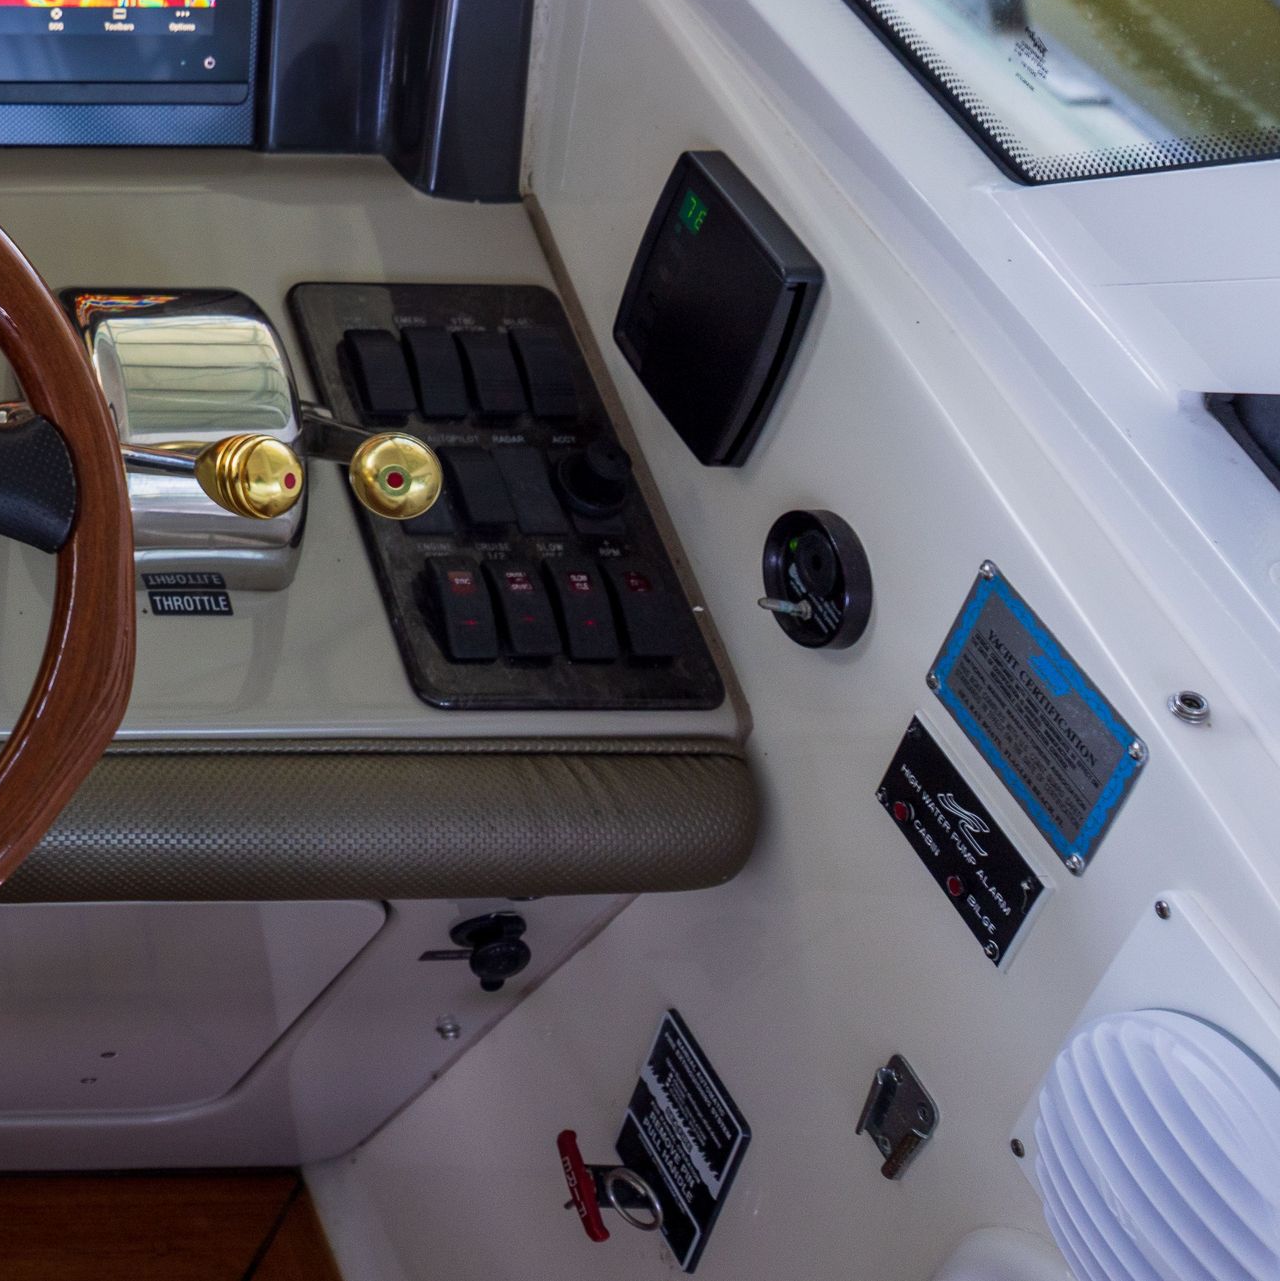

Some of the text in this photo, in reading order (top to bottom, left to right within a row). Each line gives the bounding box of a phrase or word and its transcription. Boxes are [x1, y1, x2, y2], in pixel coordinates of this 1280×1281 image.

[492, 435, 525, 444] RADAR
[152, 596, 230, 612] THROTTLE
[986, 628, 1019, 672] YACHT
[1017, 666, 1098, 769] CERTIFICATION
[900, 762, 1011, 917] HIGH WATER PUMP ALARM
[912, 817, 996, 936] CABIN BILGE
[642, 1115, 662, 1152] PULL
[661, 1148, 693, 1204] HANDLE
[649, 1110, 681, 1166] REMOVE
[680, 1162, 694, 1189] PIN
